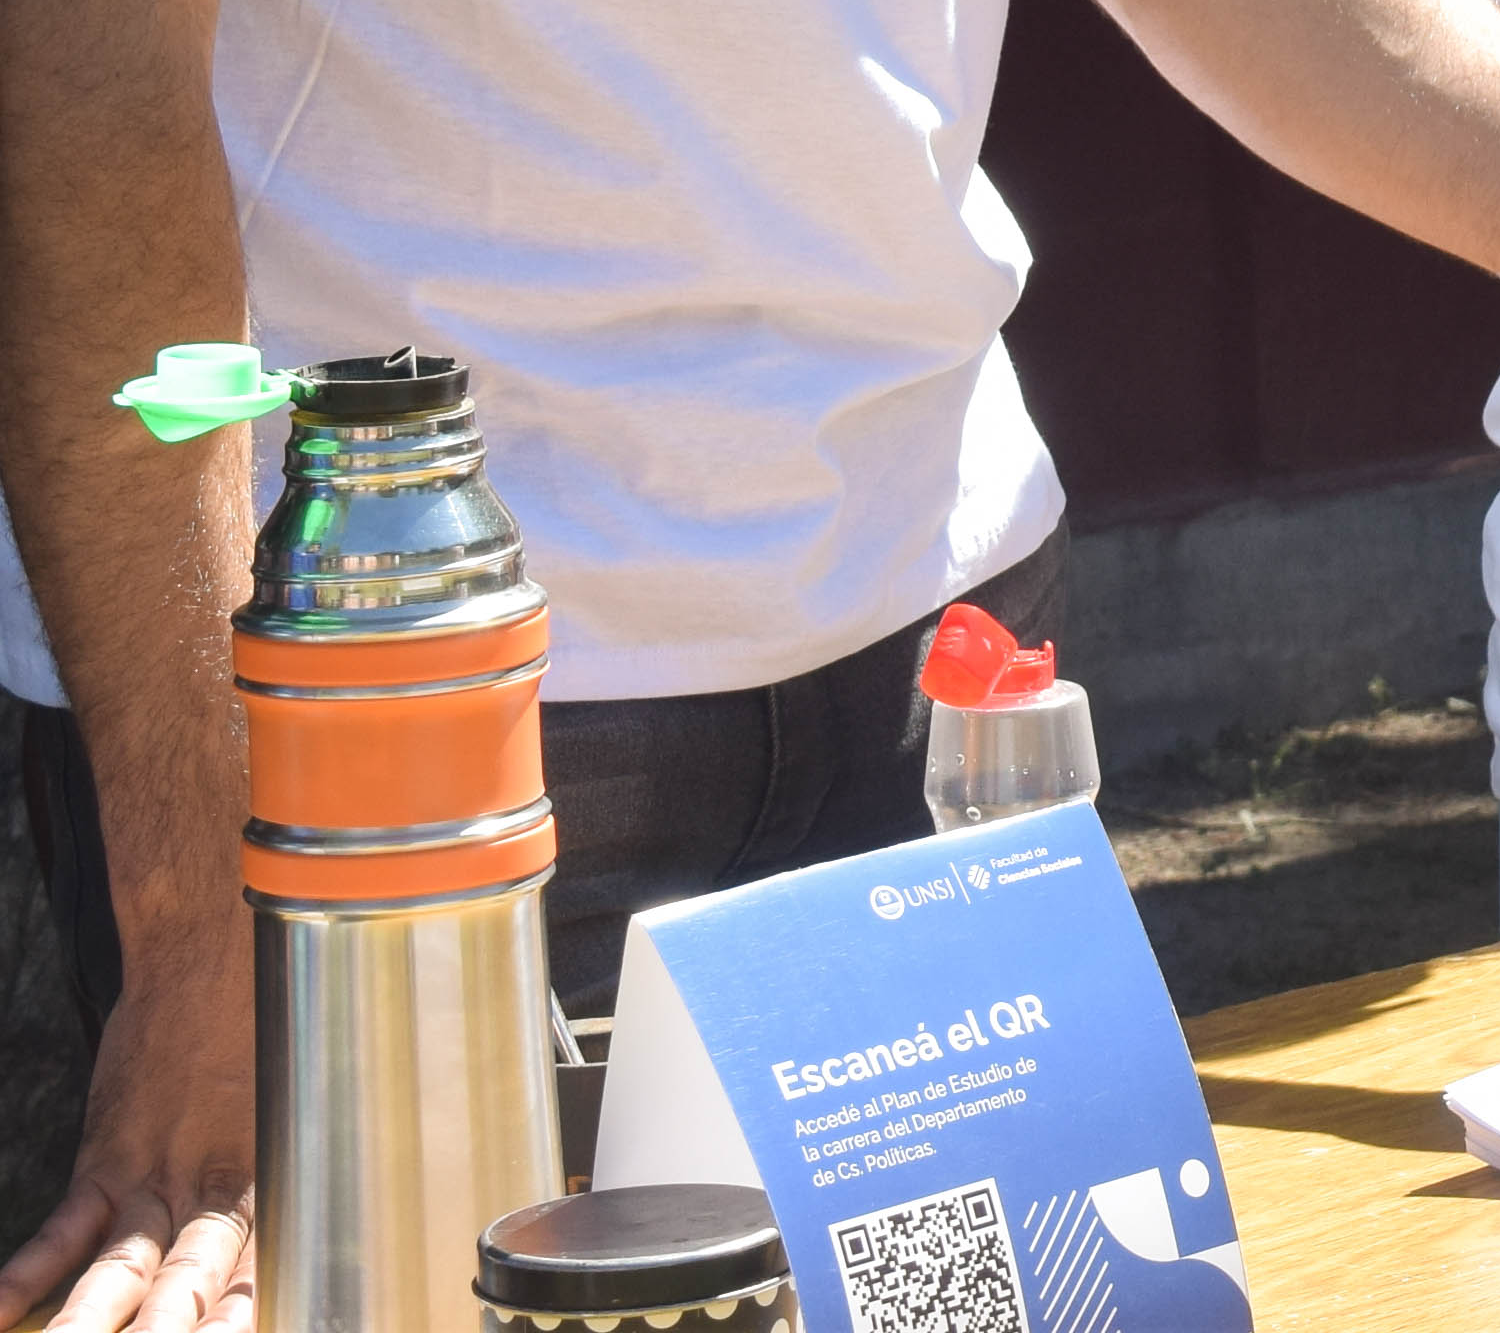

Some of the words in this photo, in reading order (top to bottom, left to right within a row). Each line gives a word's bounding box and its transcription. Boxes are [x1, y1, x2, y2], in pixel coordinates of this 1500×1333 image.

[903, 877, 956, 907] UNSJ
[990, 849, 1033, 869] Facultad
[1033, 846, 1048, 859] de
[771, 1021, 944, 1101] Escaneá
[947, 1009, 990, 1052] el
[989, 994, 1051, 1039] QR
[795, 1103, 861, 1138] Accedé
[864, 1098, 883, 1118] al
[881, 1088, 922, 1114] Plan
[923, 1080, 948, 1101] de
[948, 1061, 1013, 1094] Estudio
[1014, 1056, 1037, 1076] de
[801, 1145, 820, 1163] la
[822, 1129, 882, 1158] carrera
[883, 1117, 912, 1140] del
[911, 1086, 1027, 1133] Departamento
[812, 1166, 836, 1187] de
[837, 1160, 864, 1180] Cs.
[865, 1141, 937, 1173] Políticas.
